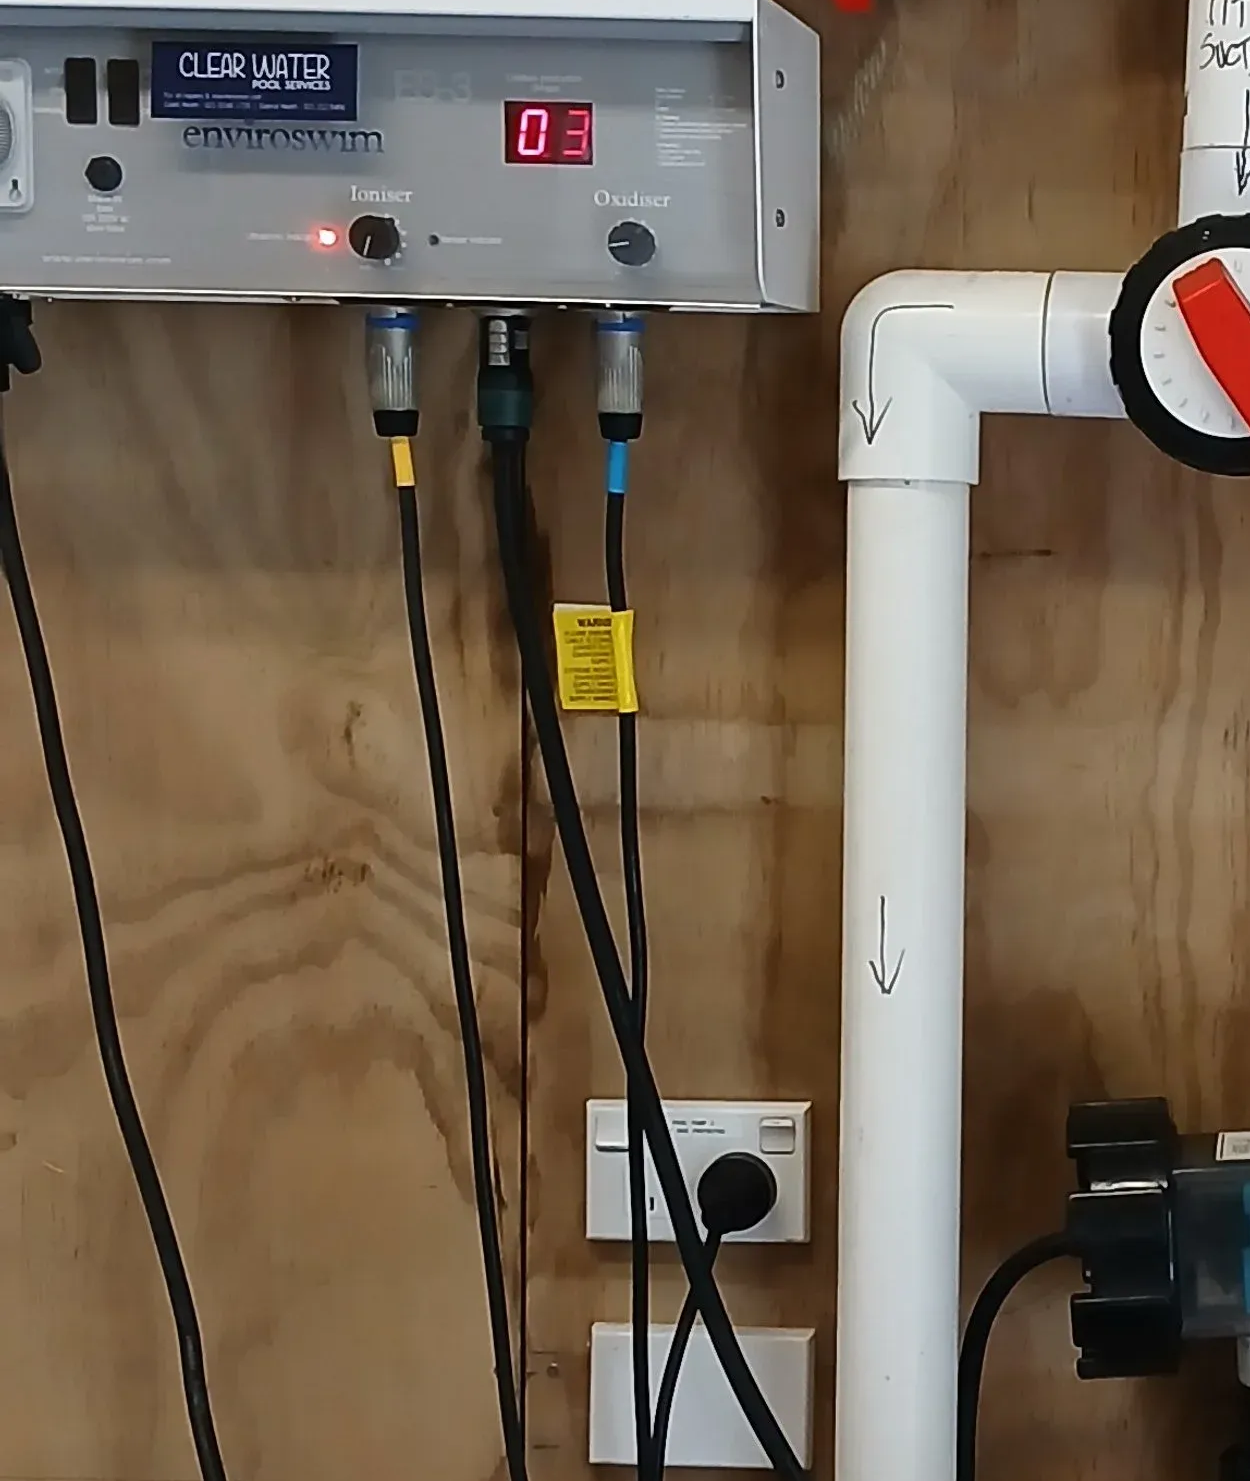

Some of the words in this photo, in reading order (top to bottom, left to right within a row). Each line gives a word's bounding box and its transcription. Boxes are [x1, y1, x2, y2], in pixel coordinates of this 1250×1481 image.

[179, 52, 246, 79] CLEAR
[252, 53, 330, 80] WATER
[252, 80, 281, 91] POOL
[284, 80, 331, 91] SERVICES
[183, 119, 384, 154] enviroswim
[517, 108, 590, 156] 03
[350, 185, 413, 203] Ioniser
[594, 189, 672, 208] Oxidiser
